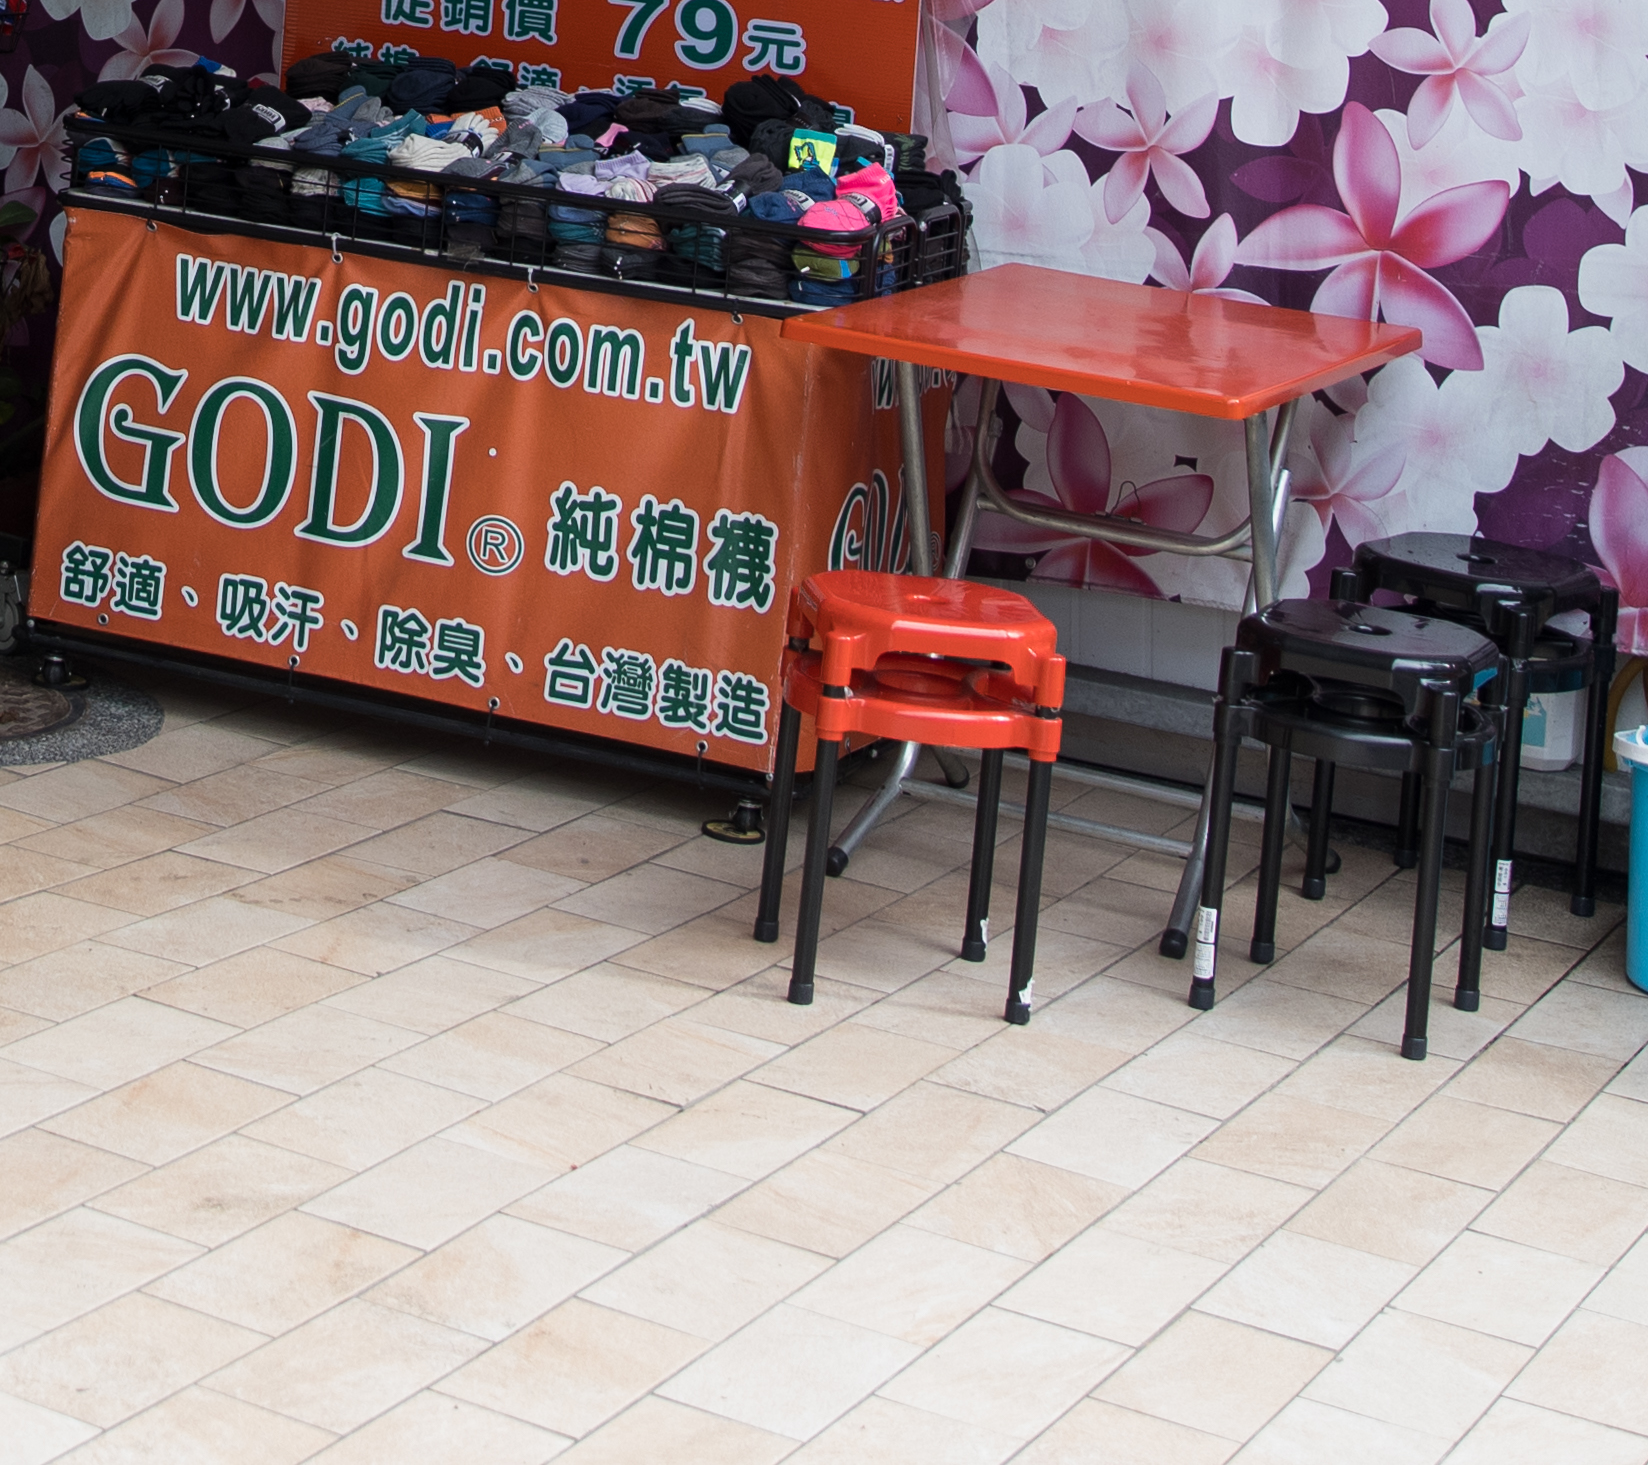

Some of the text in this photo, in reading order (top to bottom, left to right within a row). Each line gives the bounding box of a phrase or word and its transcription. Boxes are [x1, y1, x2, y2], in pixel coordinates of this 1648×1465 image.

[175, 252, 753, 415] www.godi.com.tw
[73, 352, 471, 569] GODI
[546, 480, 780, 614] 純棉襪
